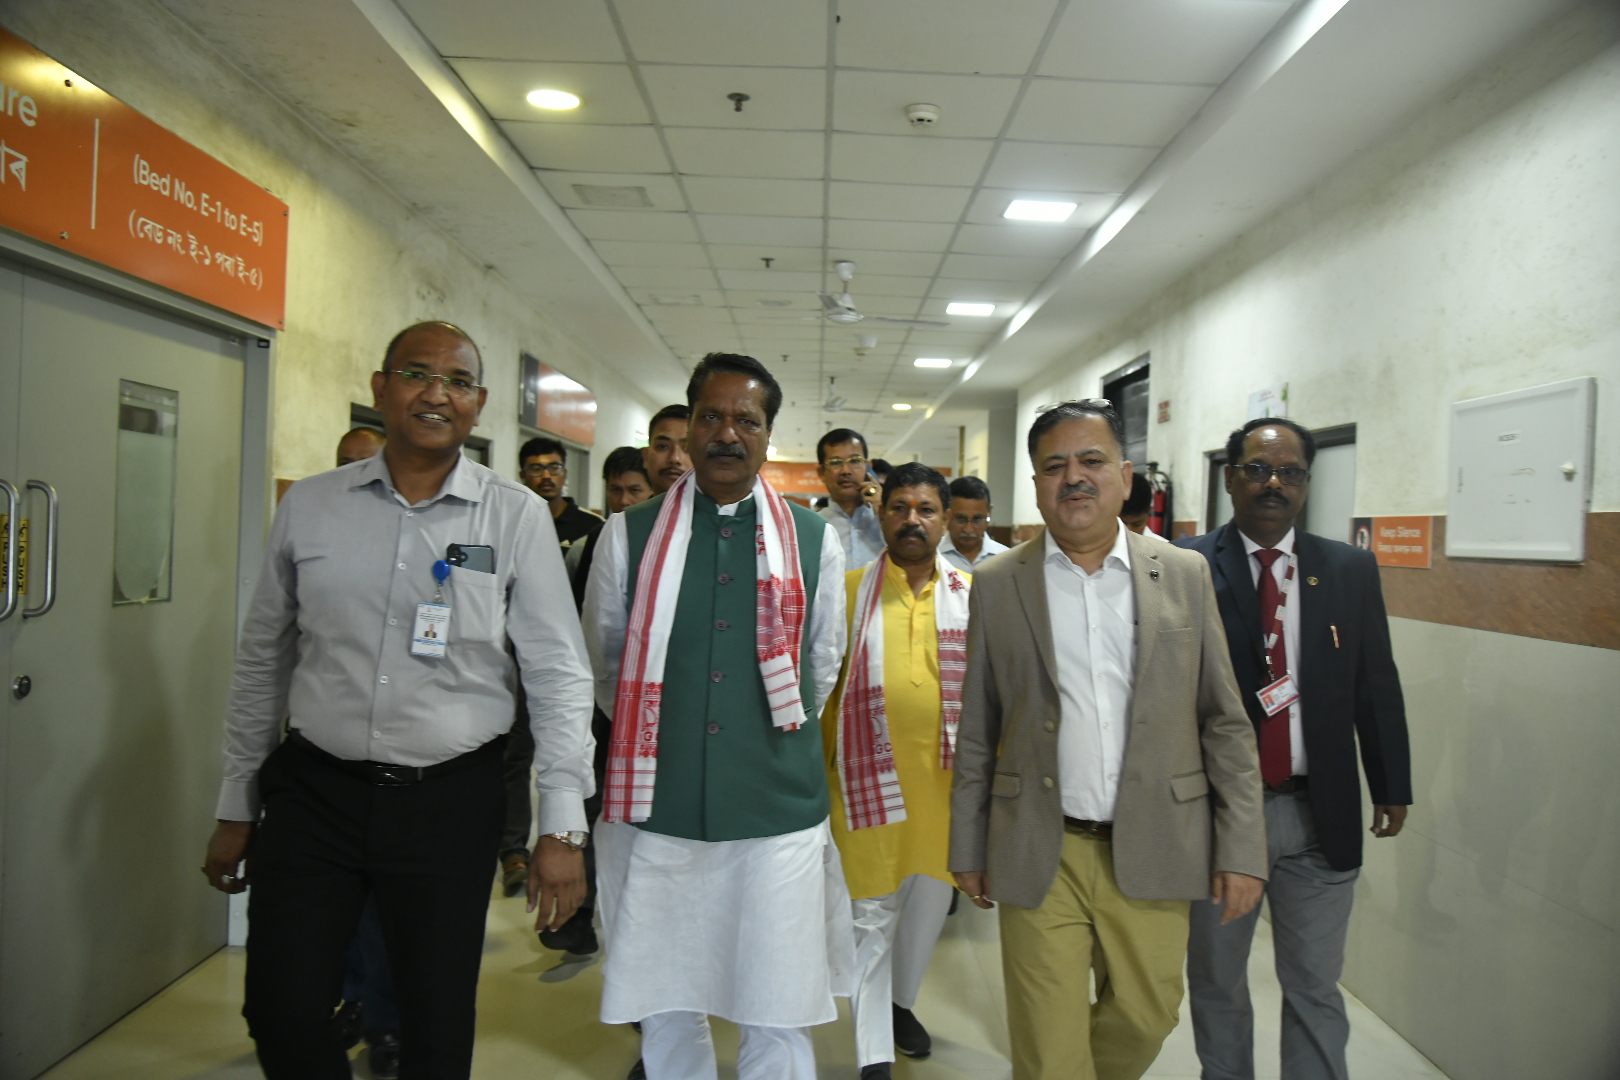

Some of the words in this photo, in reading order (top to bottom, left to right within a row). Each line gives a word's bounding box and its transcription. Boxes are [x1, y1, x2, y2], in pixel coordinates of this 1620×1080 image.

[0, 82, 38, 127] re
[132, 153, 171, 197] (Bed
[174, 178, 198, 211] No.
[201, 193, 222, 223] E-1
[224, 208, 238, 231] to
[240, 214, 264, 247] E-5)
